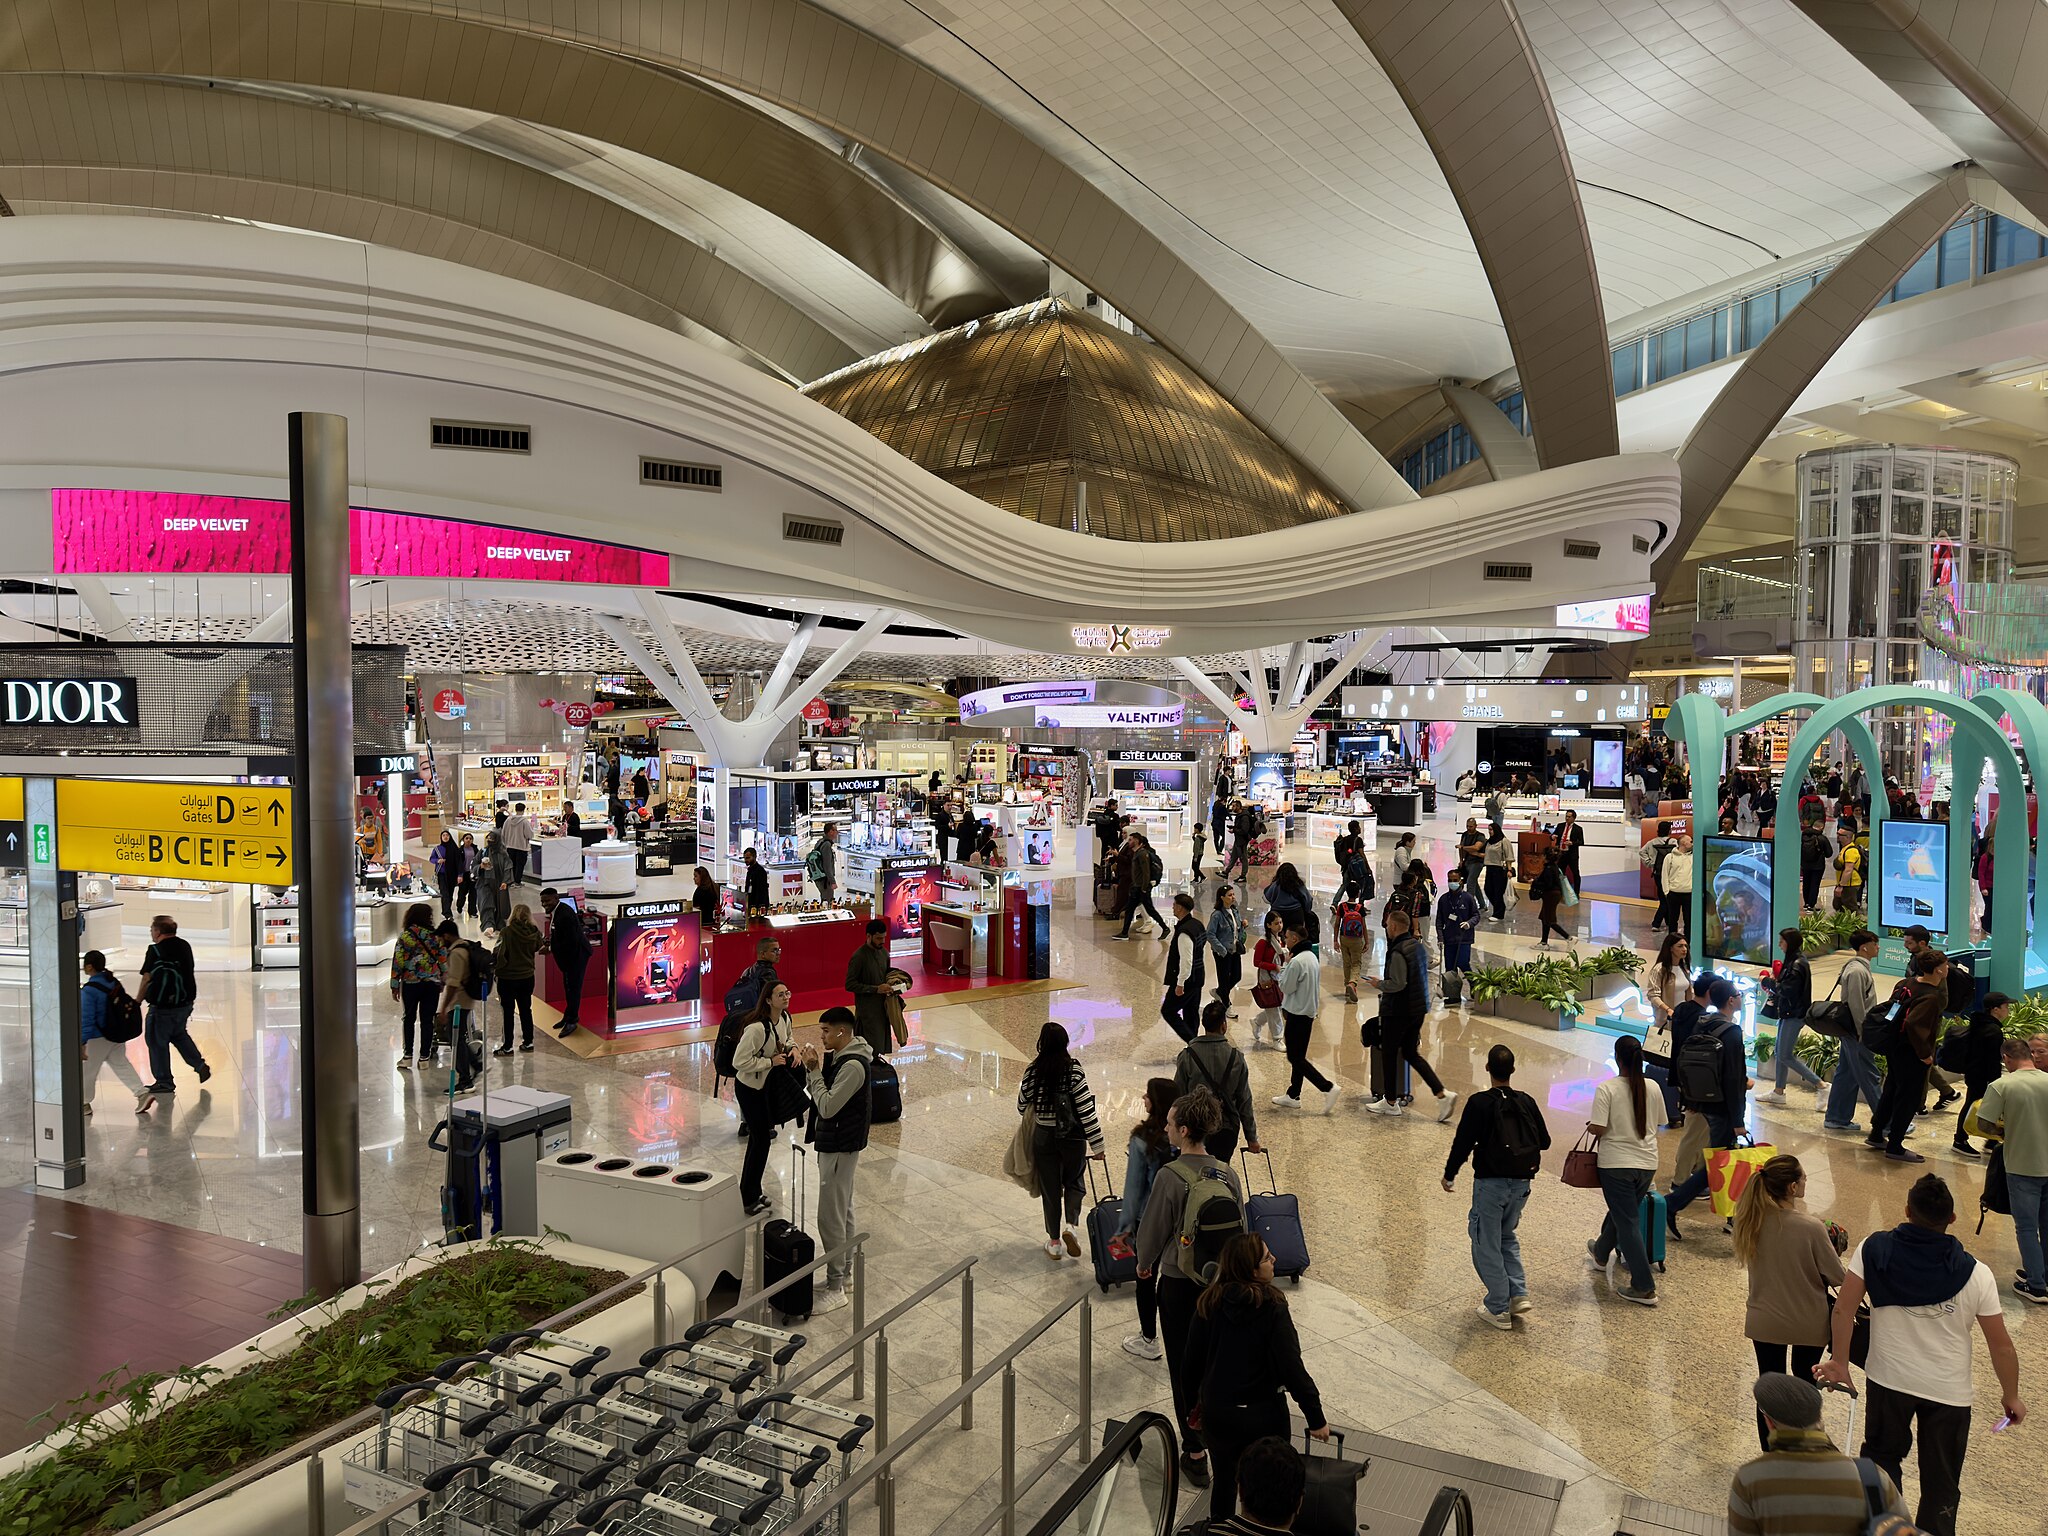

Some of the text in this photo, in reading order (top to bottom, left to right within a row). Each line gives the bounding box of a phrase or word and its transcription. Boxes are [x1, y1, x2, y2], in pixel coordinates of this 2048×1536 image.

[163, 519, 248, 531] DEEP VELVET
[487, 546, 571, 563] DEEP VELVET
[3, 680, 130, 724] DIOR
[961, 699, 977, 715] DAY
[569, 709, 589, 718] 20%
[1462, 705, 1503, 717] CHANEL
[483, 757, 538, 766] GUERLAIN
[1147, 752, 1182, 761] LAUDER
[380, 757, 414, 772] DIOR
[832, 780, 872, 790] LANCÔME
[180, 795, 213, 808] البوابات
[216, 795, 235, 824] D
[182, 811, 213, 823] Gates
[113, 834, 145, 847] البوابات
[116, 849, 145, 862] Gates
[891, 858, 929, 868] GUERLAIN
[627, 903, 680, 916] GUERLAIN
[1885, 953, 1901, 961] Find
